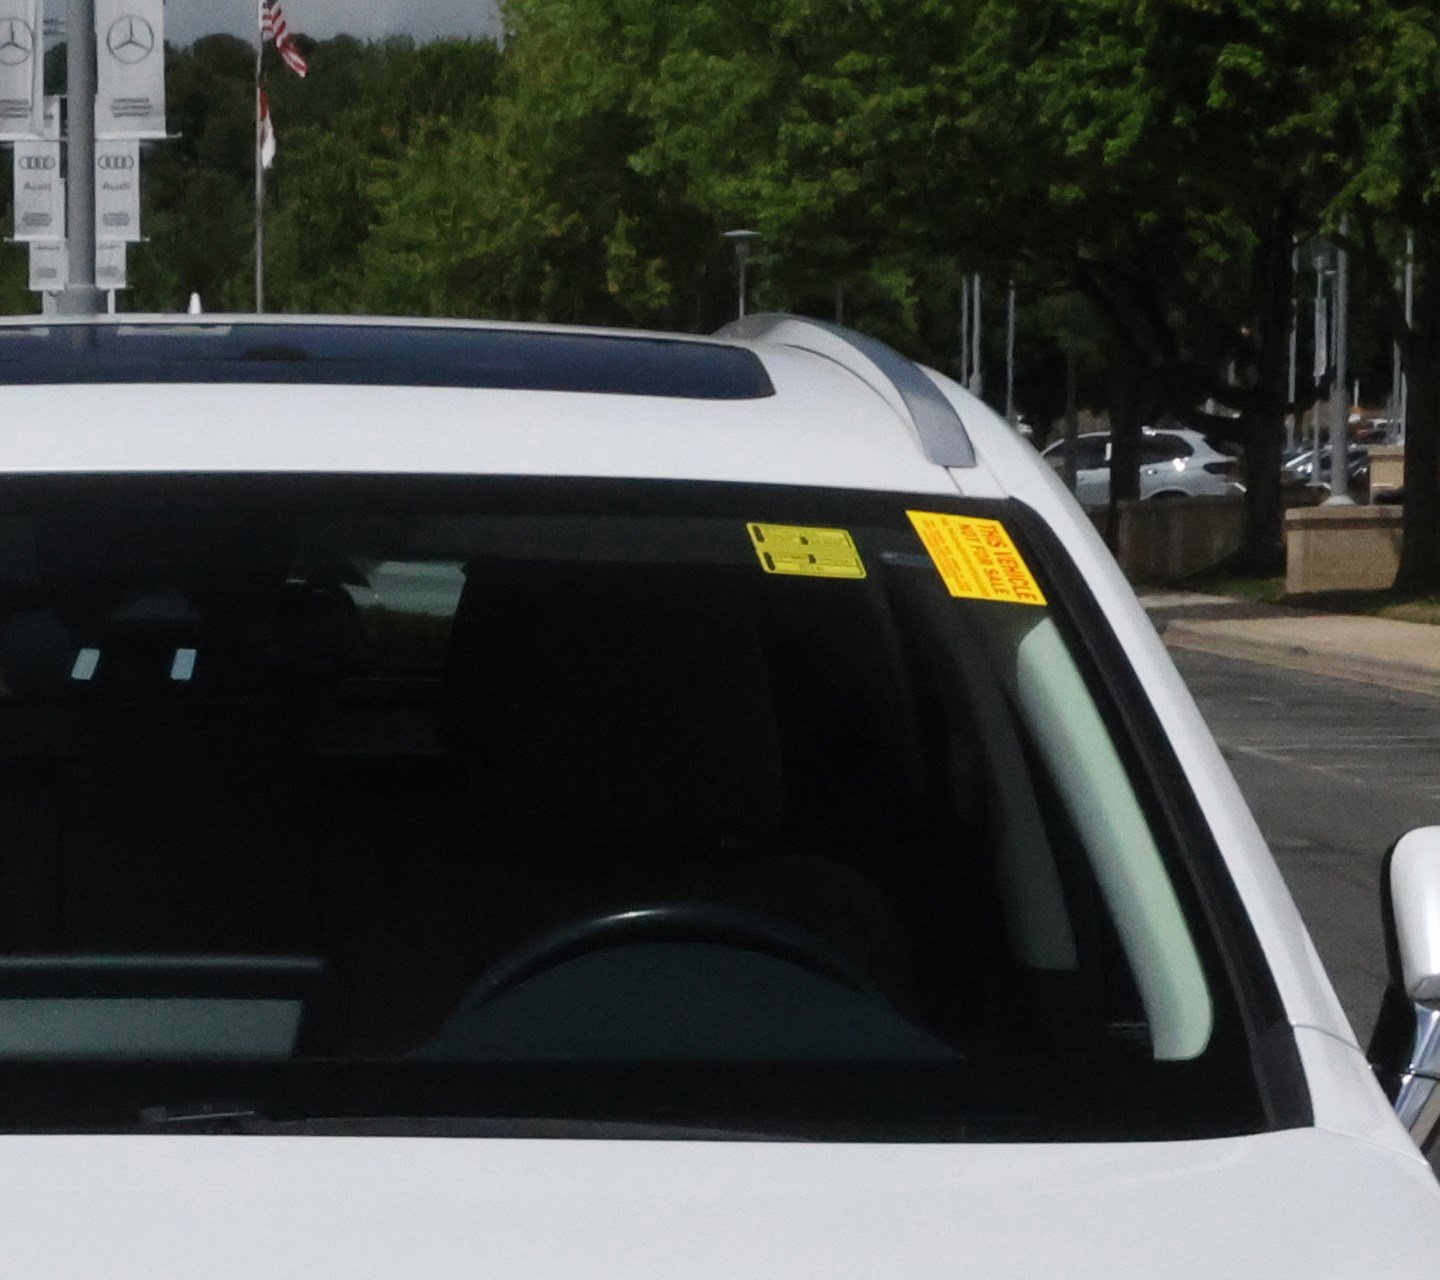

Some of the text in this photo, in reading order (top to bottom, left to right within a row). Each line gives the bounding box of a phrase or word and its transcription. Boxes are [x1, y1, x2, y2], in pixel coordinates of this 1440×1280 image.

[958, 523, 983, 542] NOT
[969, 545, 994, 566] FOR
[975, 524, 1038, 601] THIS VEHICLE
[983, 568, 1010, 596] SALE
